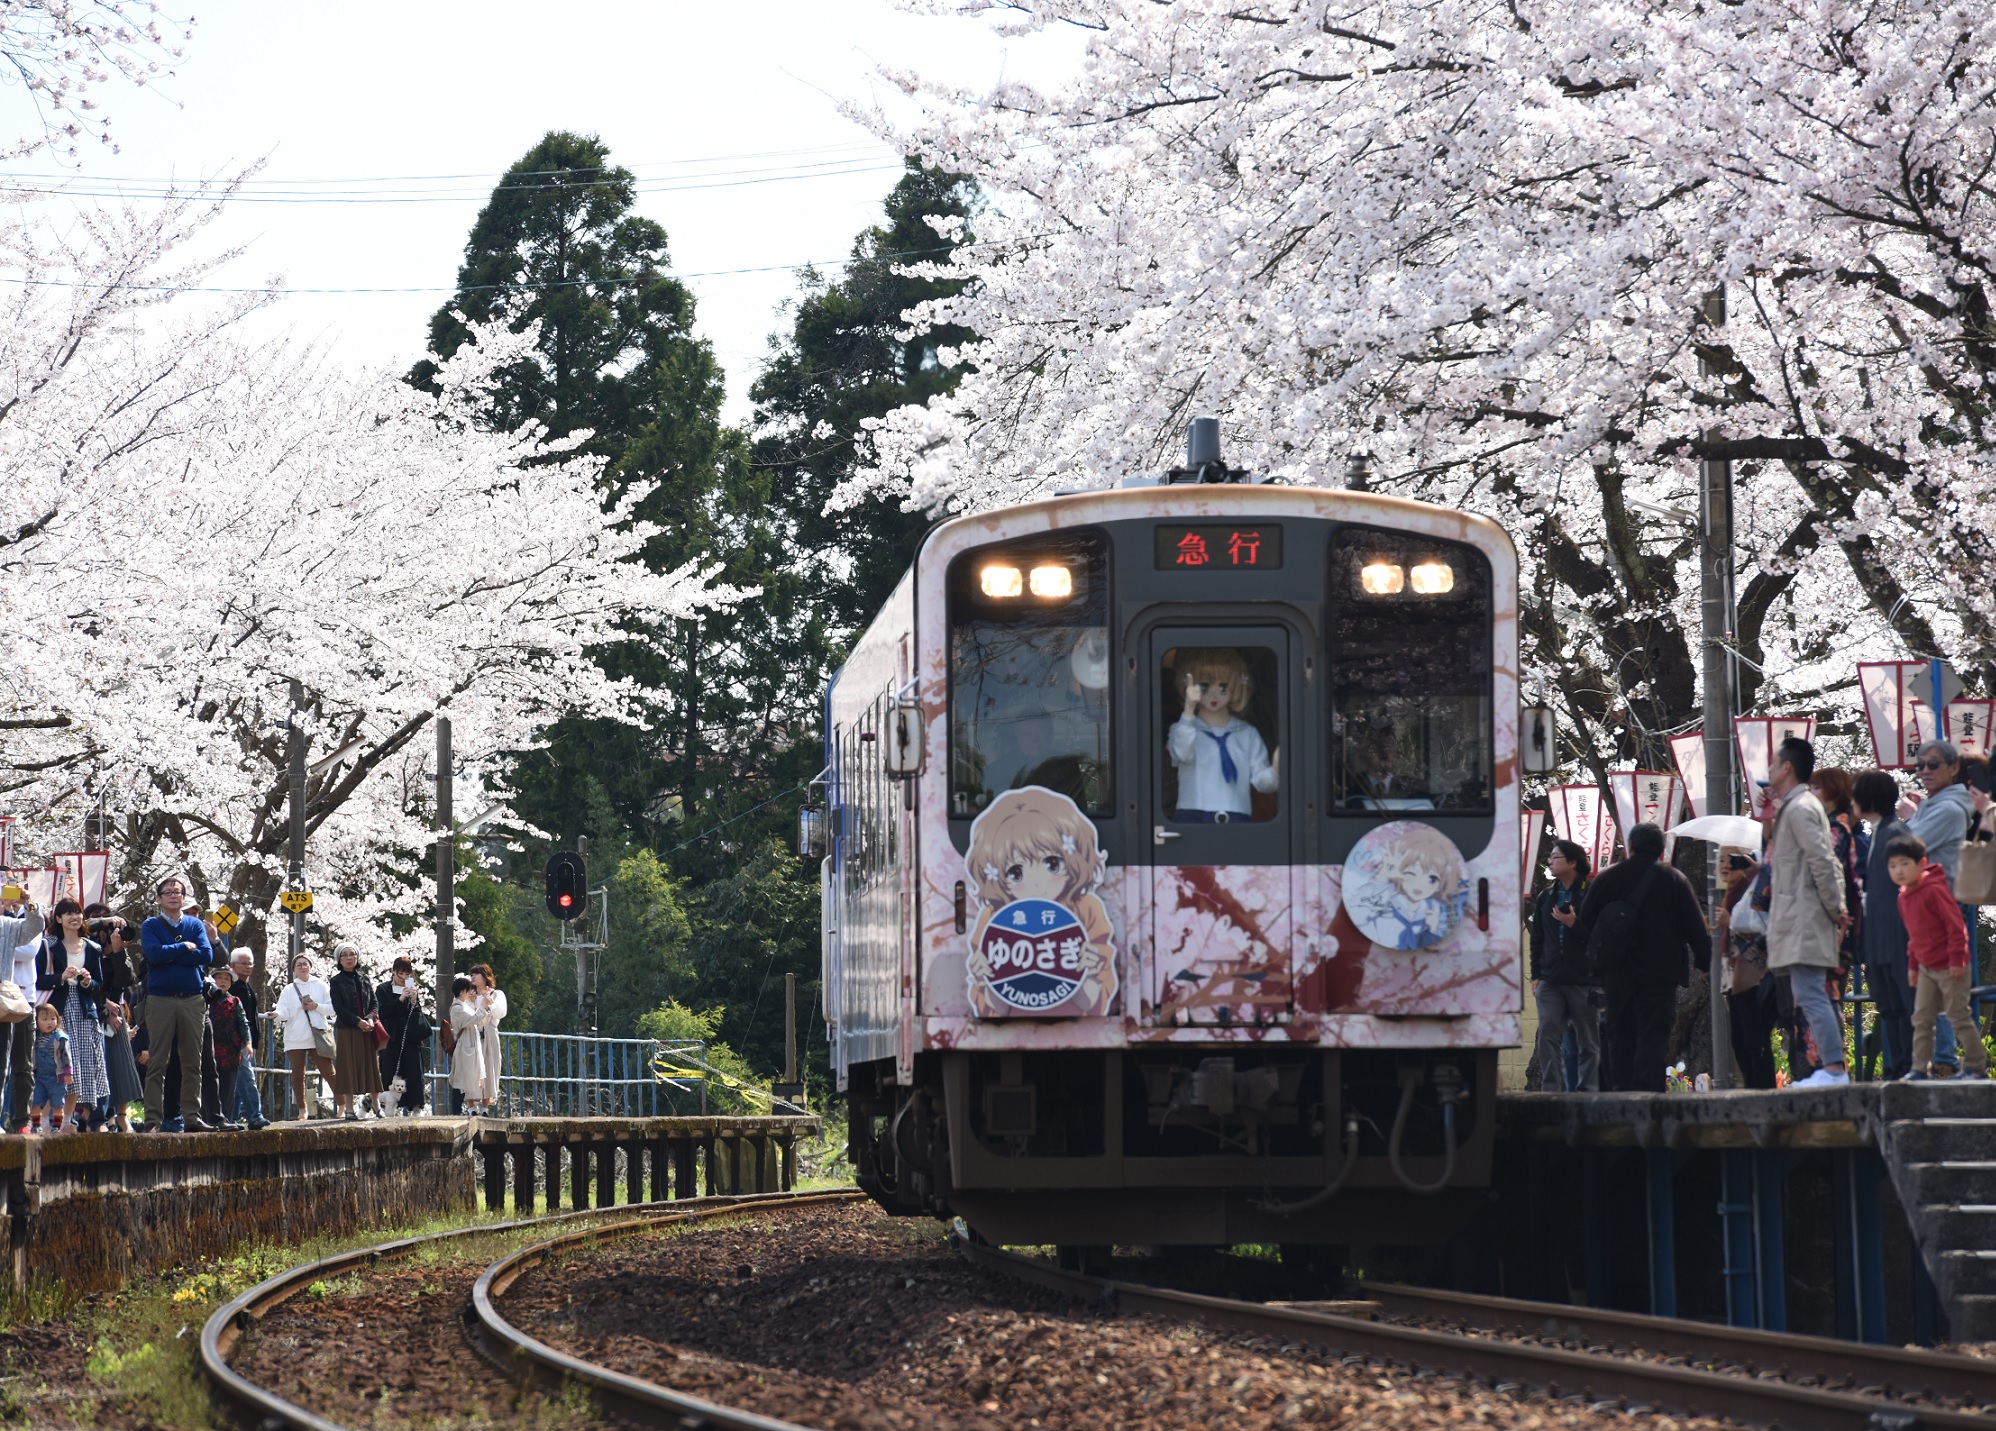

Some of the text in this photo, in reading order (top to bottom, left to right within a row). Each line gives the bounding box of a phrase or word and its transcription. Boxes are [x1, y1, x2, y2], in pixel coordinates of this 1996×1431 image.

[1176, 532, 1260, 565] 急行
[286, 893, 308, 902] ATS
[1012, 910, 1057, 925] 急行
[987, 936, 1083, 971] ゆのさぎ
[1000, 981, 1072, 1006] YUNOSAGI
